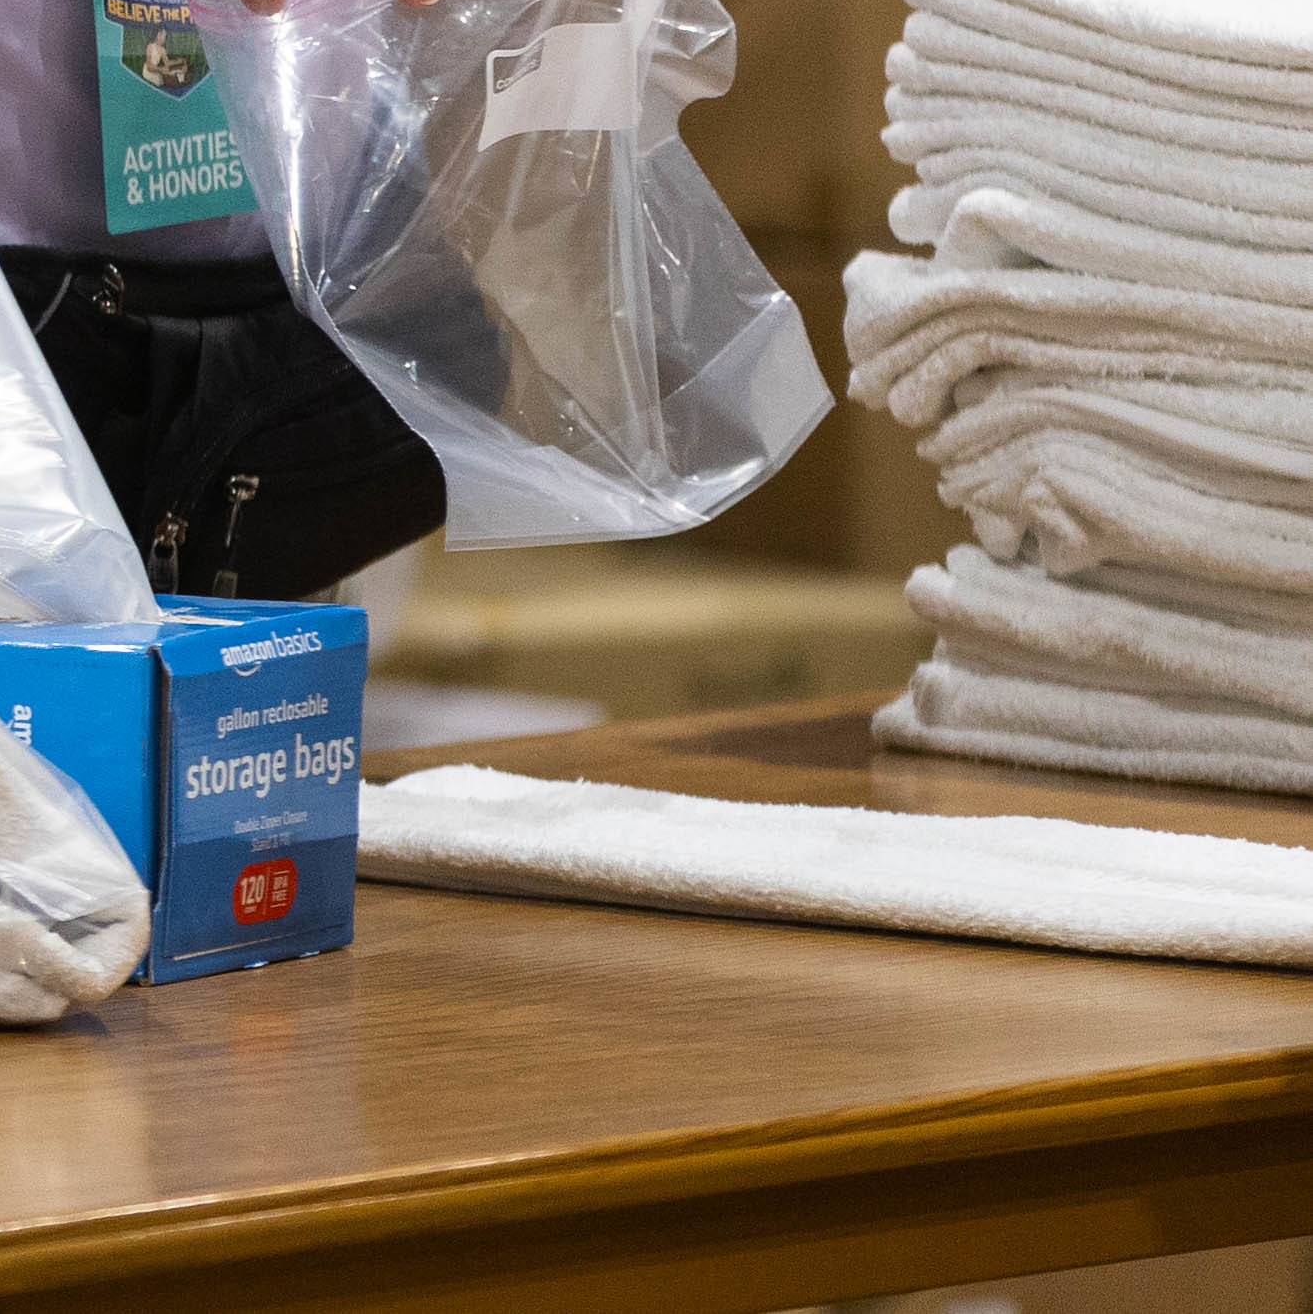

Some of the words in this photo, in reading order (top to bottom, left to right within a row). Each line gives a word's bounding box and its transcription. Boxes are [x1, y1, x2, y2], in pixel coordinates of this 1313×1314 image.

[162, 7, 181, 22] THE
[126, 176, 144, 205] &
[148, 159, 243, 202] HONORS
[220, 627, 322, 667] amazonbasics
[217, 707, 259, 739] gallon
[262, 692, 329, 725] reclosable
[186, 748, 287, 800] storage
[294, 733, 355, 785] bags
[240, 874, 265, 905] 120
